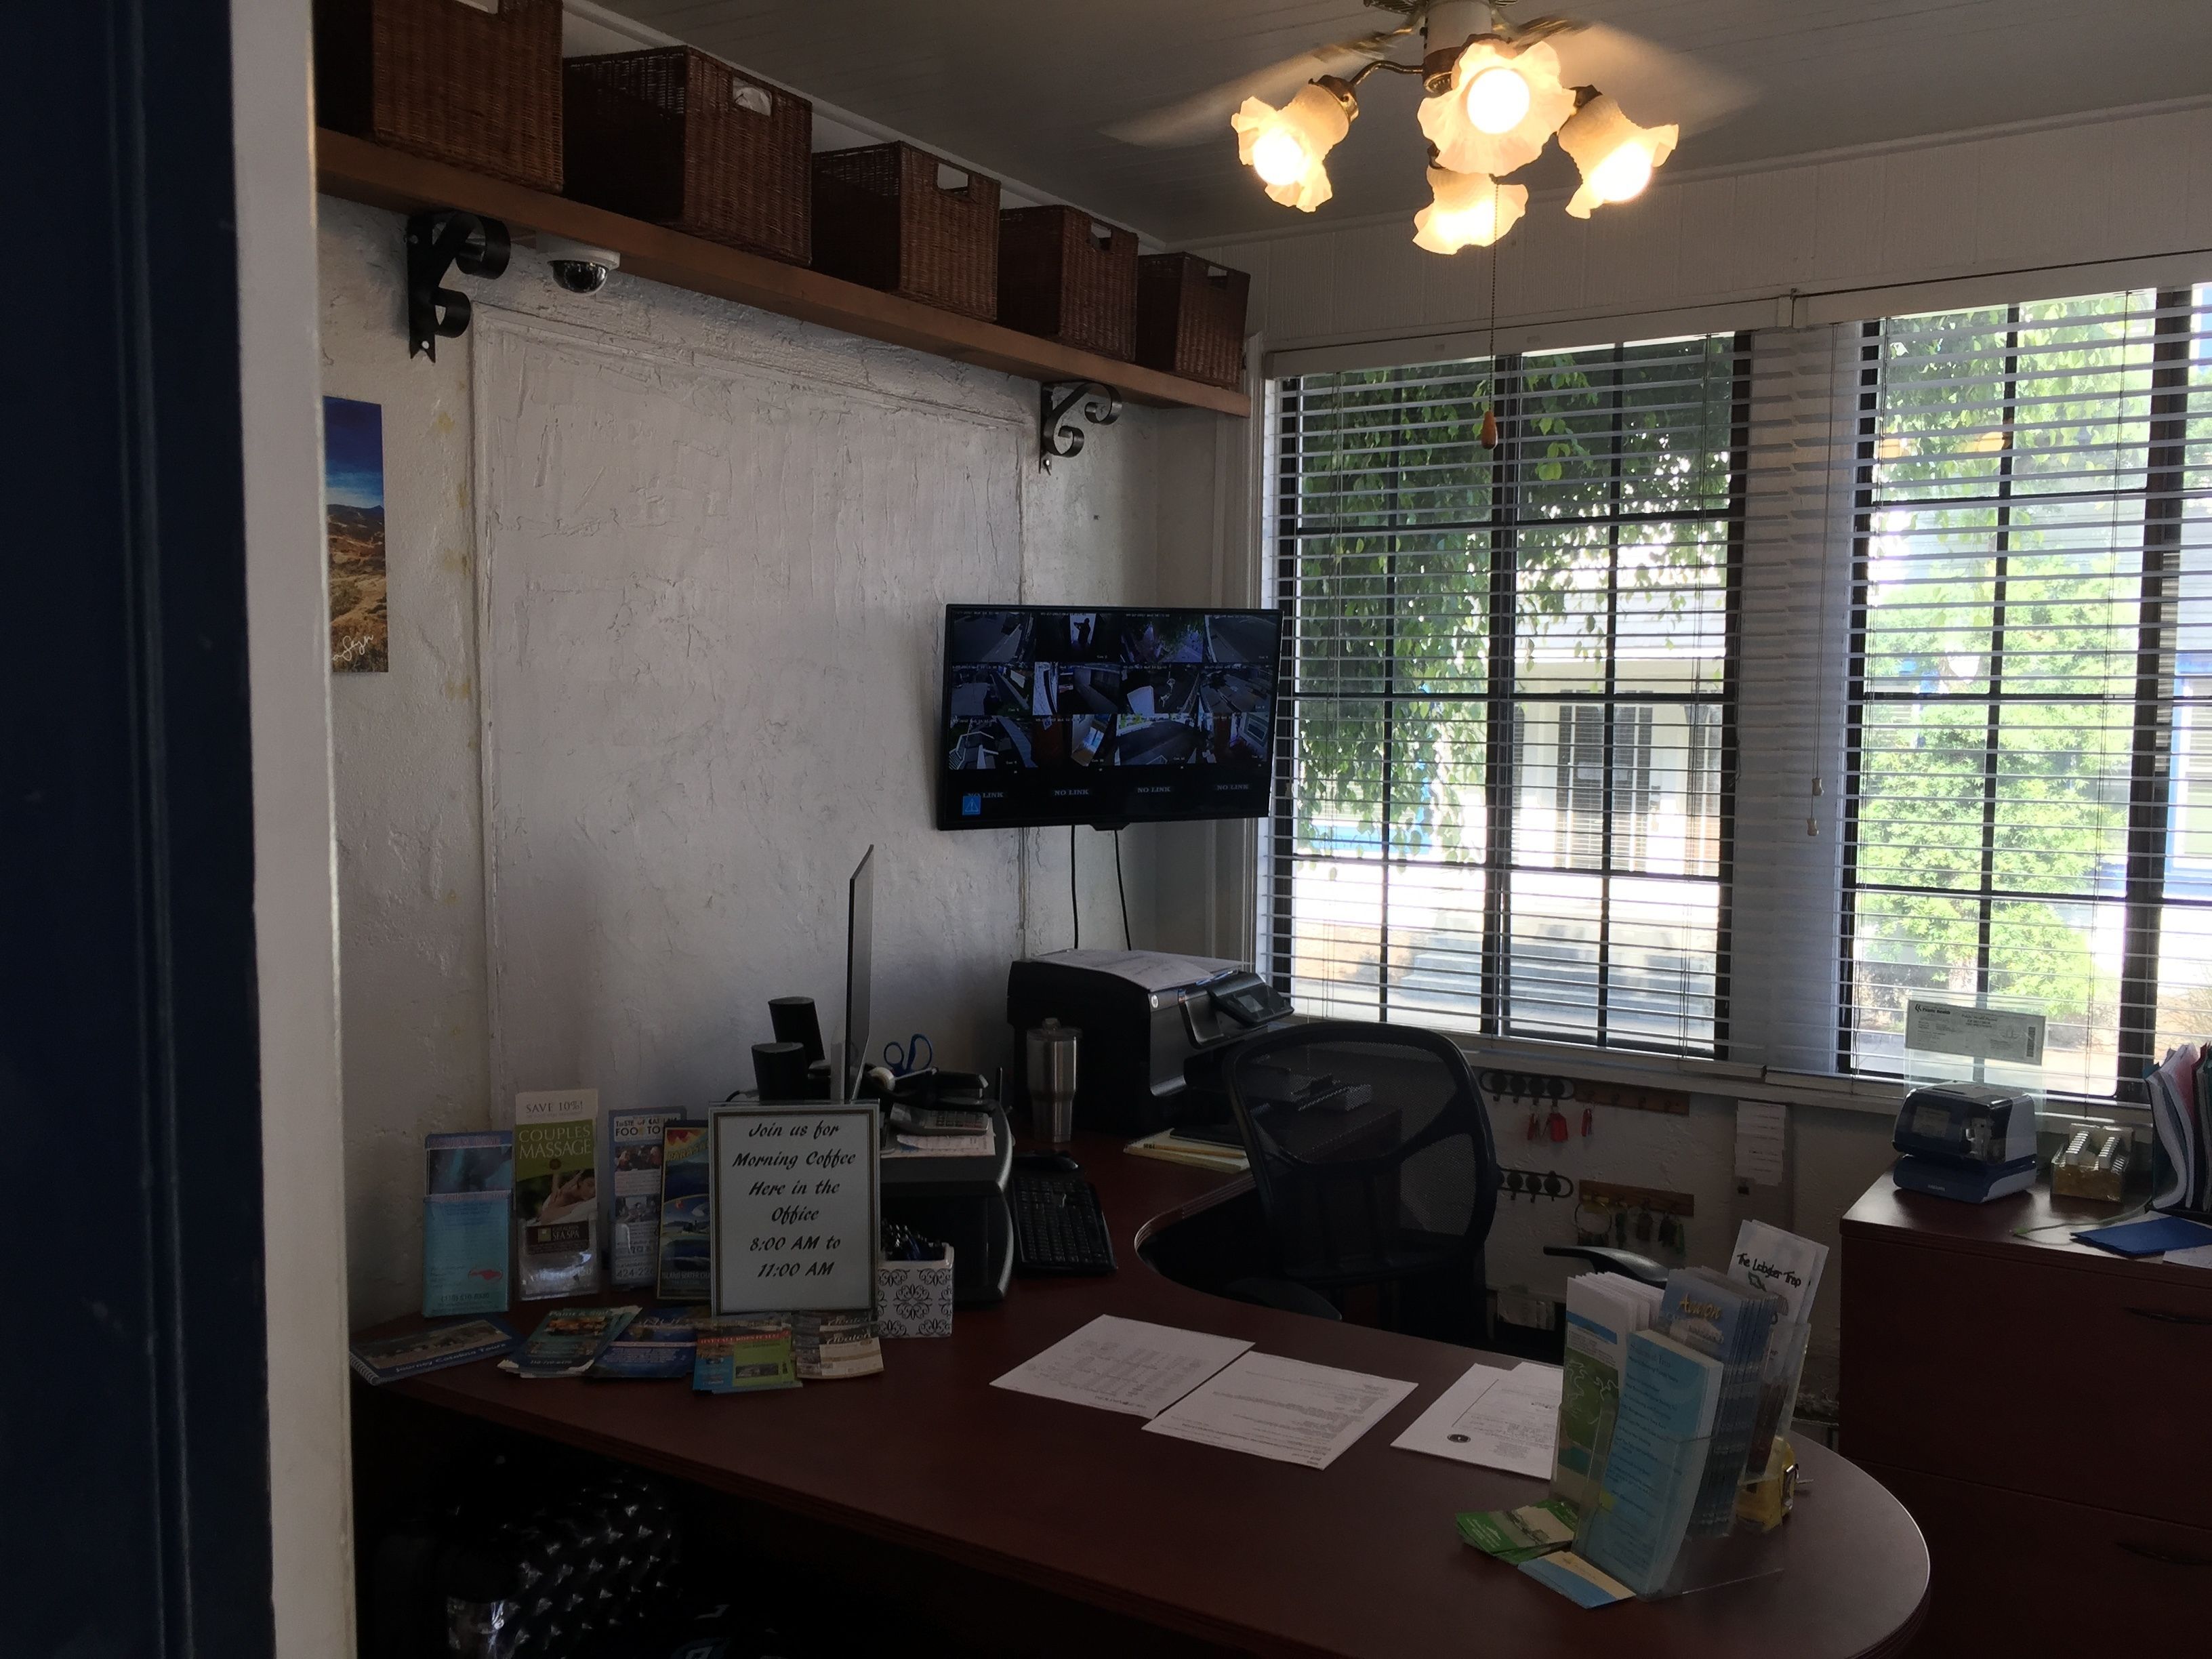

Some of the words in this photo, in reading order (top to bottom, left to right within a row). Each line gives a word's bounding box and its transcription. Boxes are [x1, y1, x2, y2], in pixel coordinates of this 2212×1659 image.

[527, 1103, 552, 1113] SAVE
[519, 1125, 590, 1143] COUPLES
[749, 1122, 782, 1137] Join
[790, 1124, 808, 1137] us
[813, 1120, 840, 1139] for
[519, 1139, 592, 1160] MASSAGE
[732, 1151, 798, 1170] Morning
[806, 1148, 857, 1169] Coffee
[749, 1181, 785, 1196] Here
[792, 1179, 806, 1195] in
[815, 1179, 840, 1195] the
[771, 1205, 819, 1225] Office
[567, 1230, 580, 1239] SPA
[750, 1236, 786, 1252] 8:00
[791, 1235, 820, 1250] AM
[826, 1235, 841, 1250] to
[1736, 1252, 1750, 1267] The
[757, 1263, 800, 1278] 11:00
[805, 1261, 835, 1276] AM
